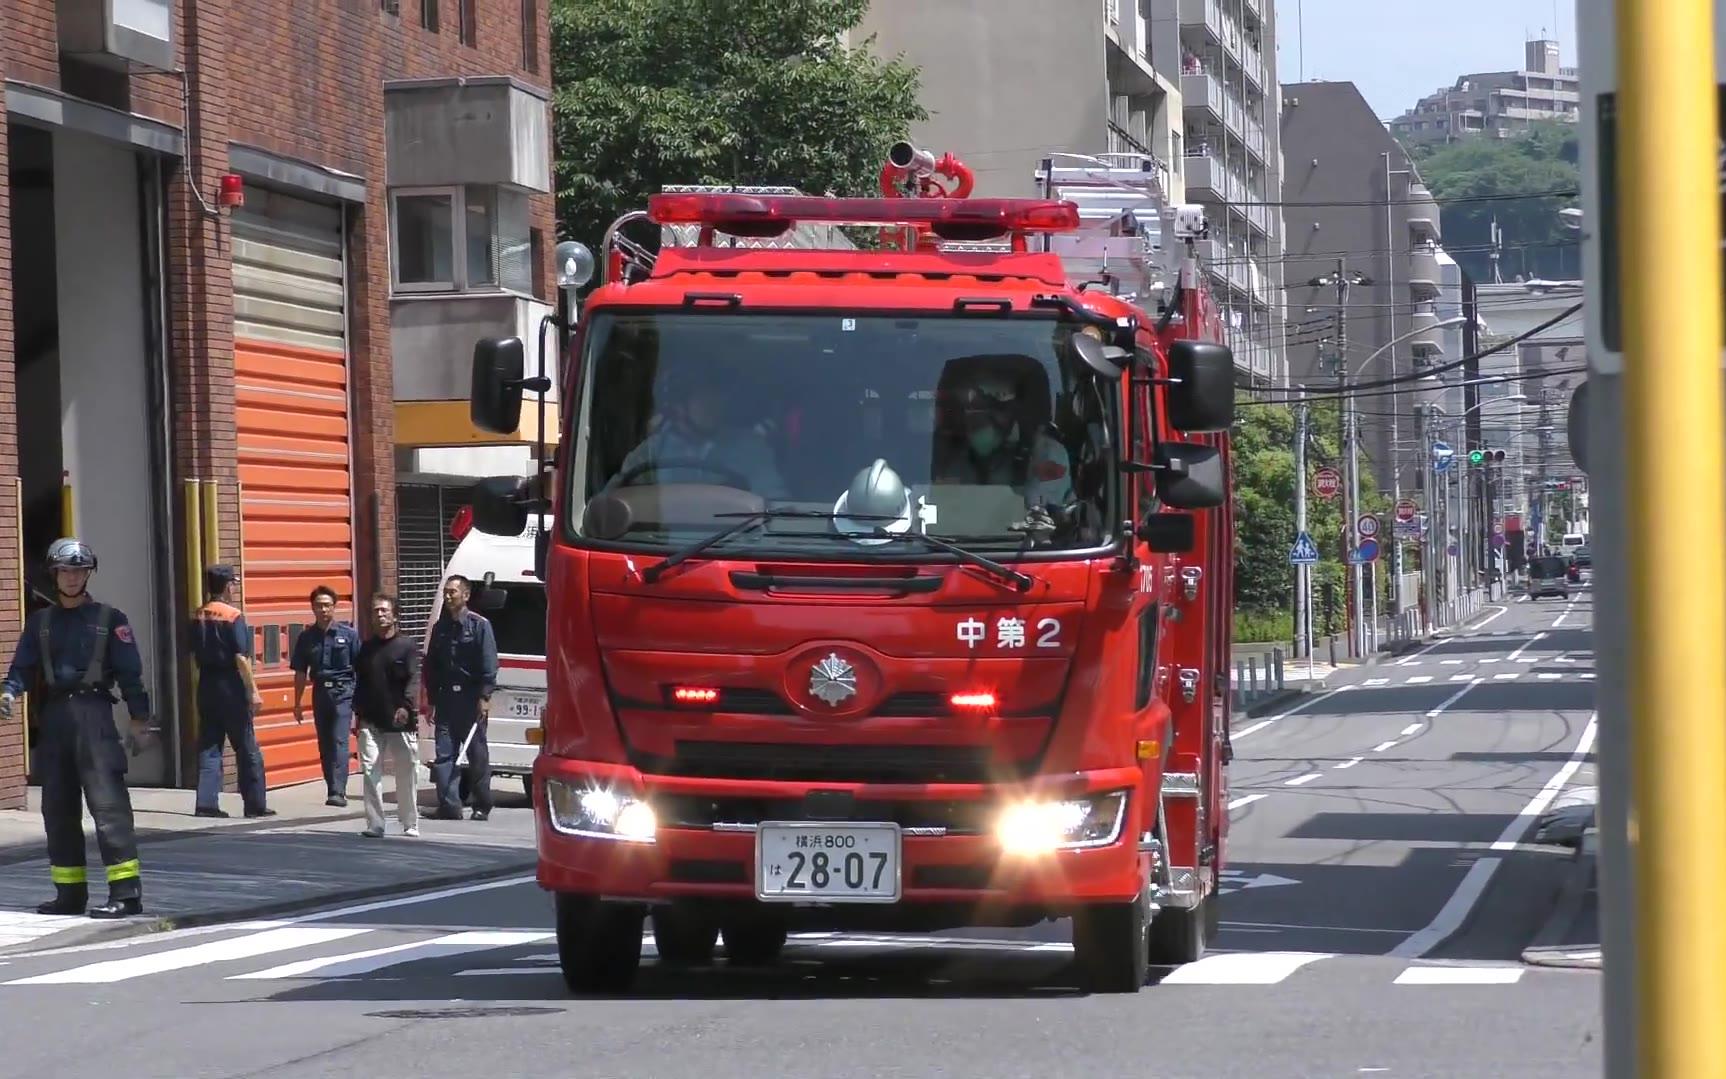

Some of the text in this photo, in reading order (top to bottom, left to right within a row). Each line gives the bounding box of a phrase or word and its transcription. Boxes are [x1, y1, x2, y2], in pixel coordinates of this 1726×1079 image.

[1362, 521, 1375, 532] 40
[770, 851, 888, 889] は 28-07
